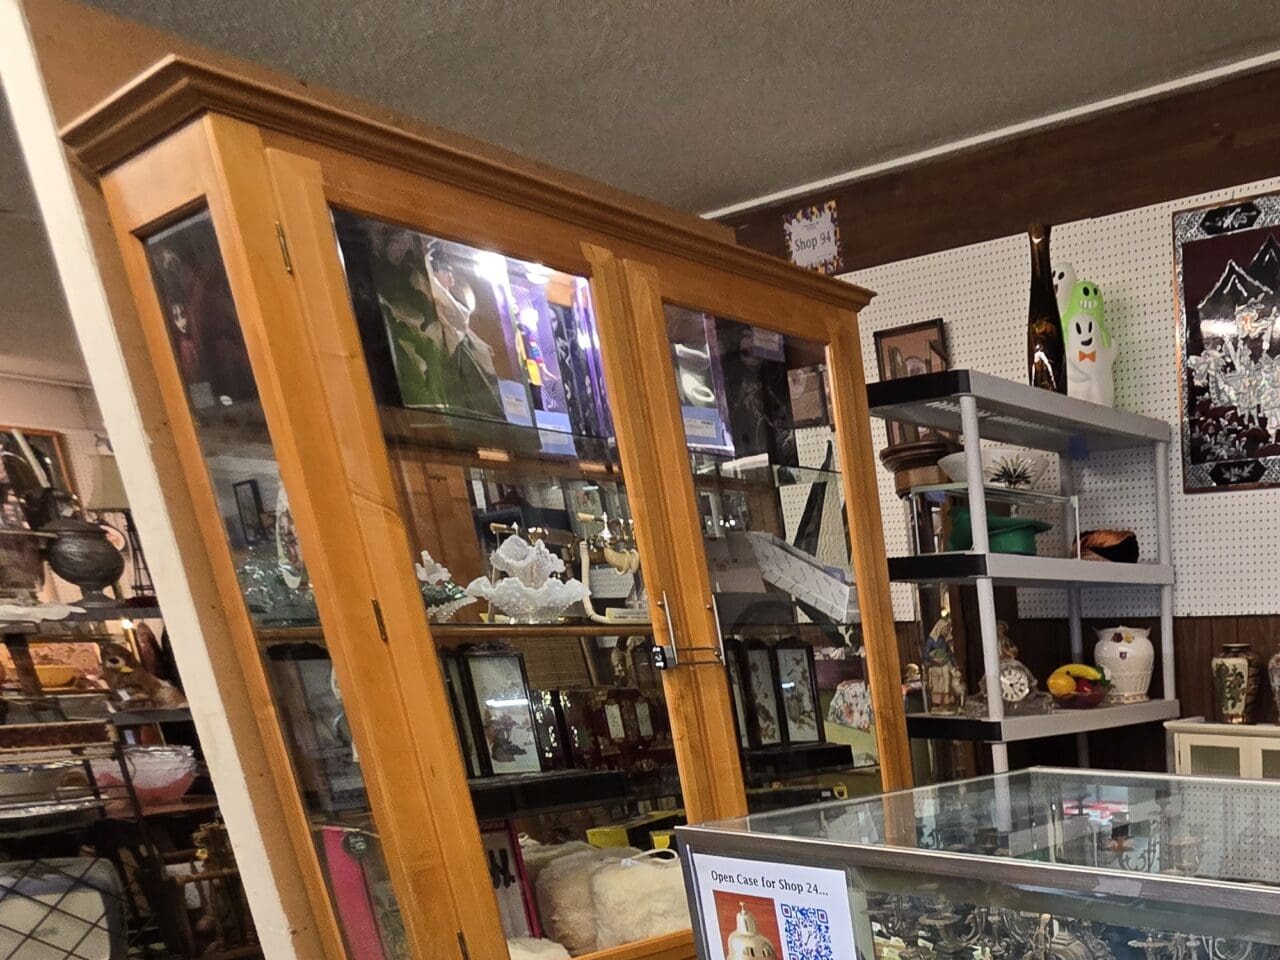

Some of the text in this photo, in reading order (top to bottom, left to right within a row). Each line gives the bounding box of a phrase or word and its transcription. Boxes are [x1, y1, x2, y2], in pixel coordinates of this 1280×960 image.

[795, 230, 831, 252] Shop 94
[711, 870, 735, 884] Open
[737, 873, 758, 887] Case
[761, 876, 776, 889] for
[779, 878, 803, 894] Shop
